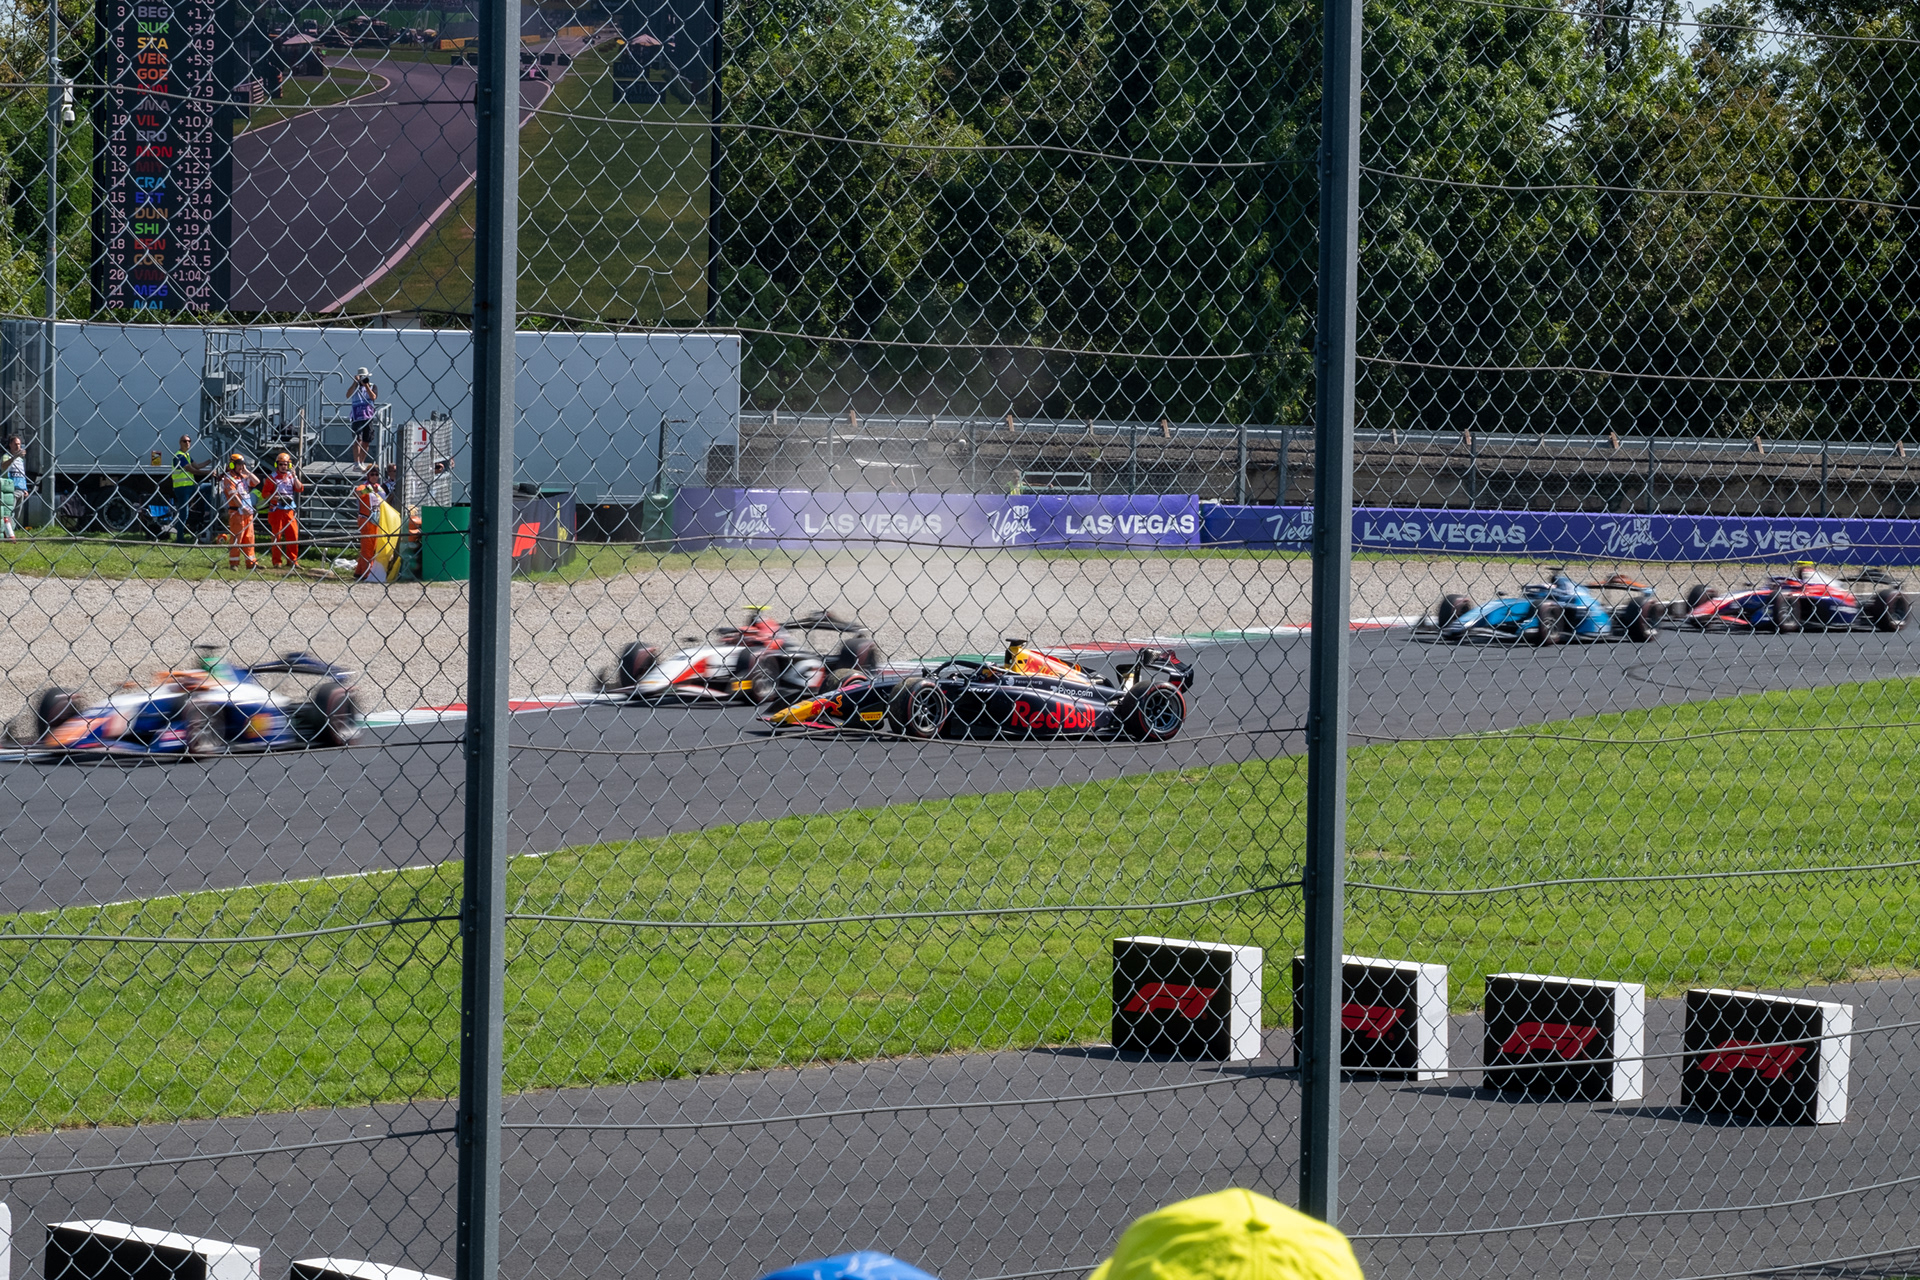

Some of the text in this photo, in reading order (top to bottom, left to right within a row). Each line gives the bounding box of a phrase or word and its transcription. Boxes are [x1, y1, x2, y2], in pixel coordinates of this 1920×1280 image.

[117, 6, 125, 17] 3
[138, 6, 168, 18] BEG
[117, 21, 125, 33] 4
[138, 22, 170, 34] DUR
[117, 37, 125, 48] 5
[137, 37, 169, 49] STA
[117, 53, 125, 64] 6
[138, 53, 167, 65] VER
[117, 68, 125, 79] 7
[137, 68, 168, 80] GOE
[112, 114, 127, 126] 10
[136, 114, 159, 126] VIL
[112, 130, 127, 141] 11
[136, 130, 167, 142] BRO
[112, 146, 127, 157] 12
[136, 146, 172, 158] MON
[111, 161, 127, 172] 13
[111, 176, 126, 188] 14
[135, 177, 166, 189] CRA
[111, 192, 126, 203] 15
[176, 193, 212, 205] +3.4
[135, 207, 168, 219] DUN
[177, 208, 212, 220] +140
[110, 222, 211, 236] 17 SHI +19.
[110, 238, 125, 250] 18
[134, 238, 166, 250] BEN
[109, 269, 125, 281] 20
[109, 285, 210, 298] 21 MEG Out
[804, 513, 942, 535] LAS VEGAS
[1301, 512, 1314, 523] LA
[1065, 514, 1195, 535] LAS VEGAS
[1266, 512, 1314, 548] Vega
[1363, 521, 1526, 544] LAS VEGAS
[1693, 528, 1850, 551] LAS VEGAS
[1010, 700, 1096, 729] Red Bull
